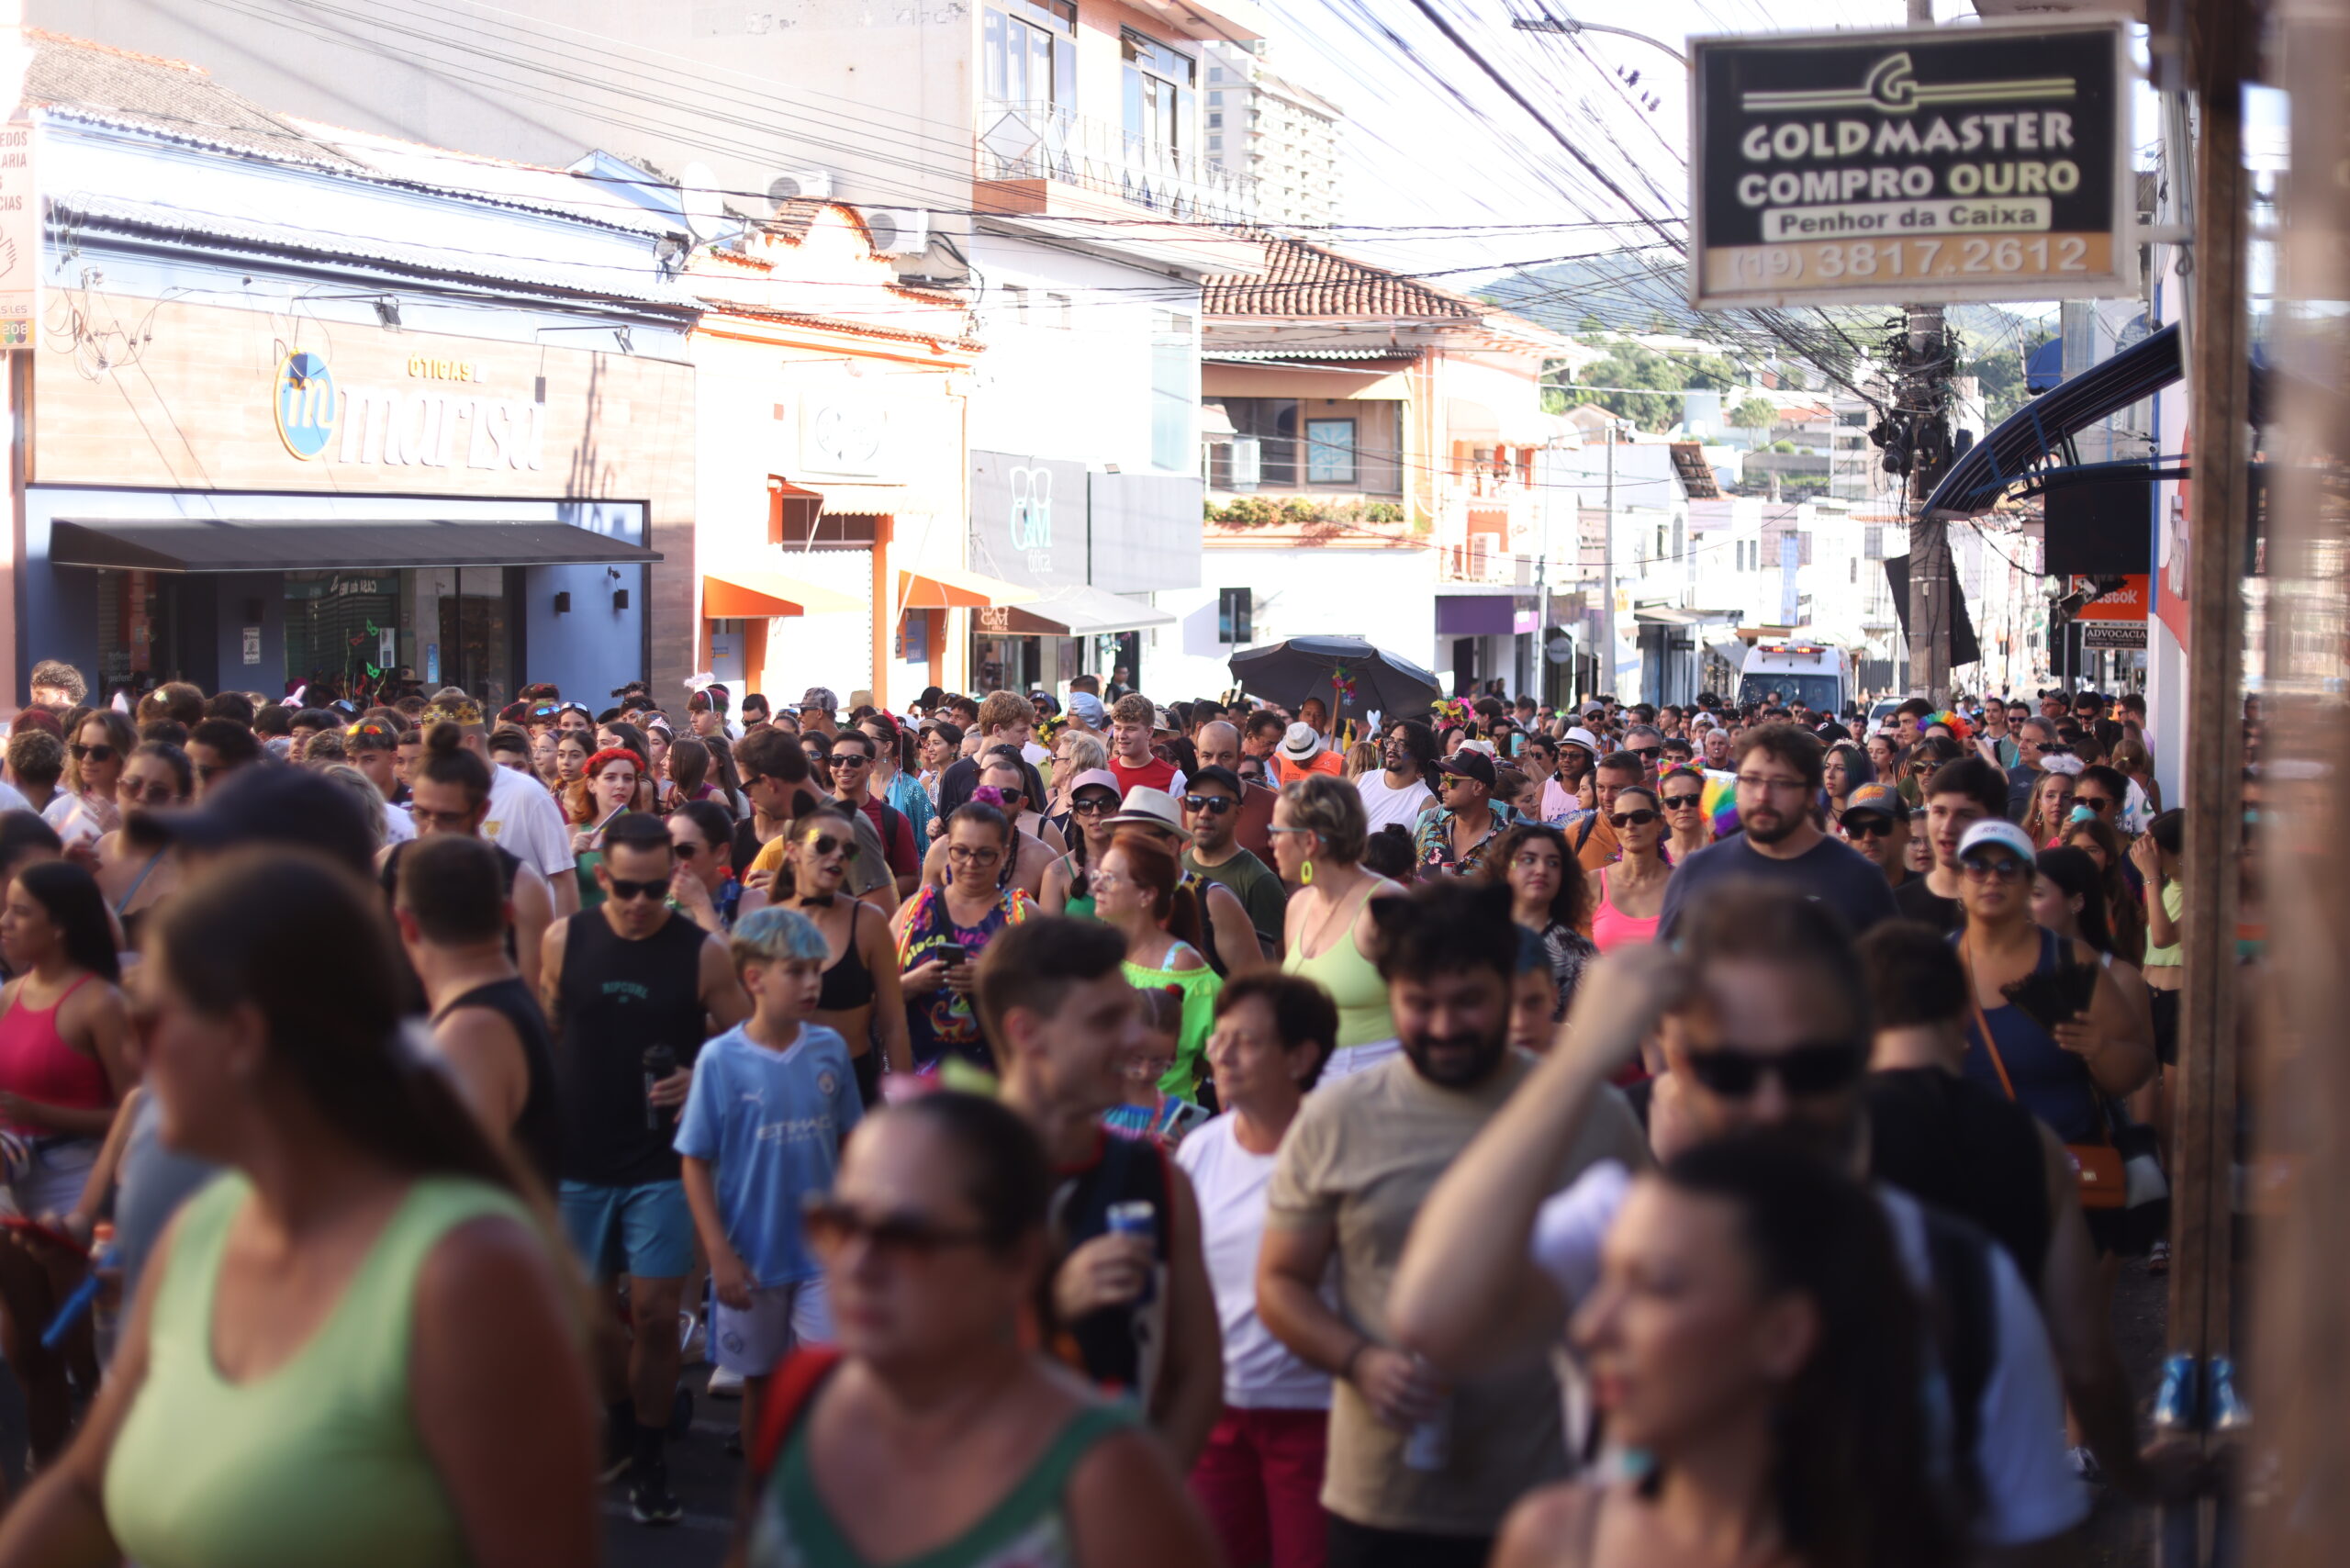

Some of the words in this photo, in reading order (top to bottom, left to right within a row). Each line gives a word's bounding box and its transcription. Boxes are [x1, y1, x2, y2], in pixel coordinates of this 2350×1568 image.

[0, 153, 28, 169] ARIA
[1738, 166, 1933, 207] COMPRO
[1948, 161, 2080, 196] OURO
[1779, 210, 1887, 235] Penhor
[1898, 206, 1937, 228] da
[1948, 204, 2038, 226] Caixa
[339, 386, 547, 471] marisa
[2087, 629, 2146, 640] ADVOCACIA
